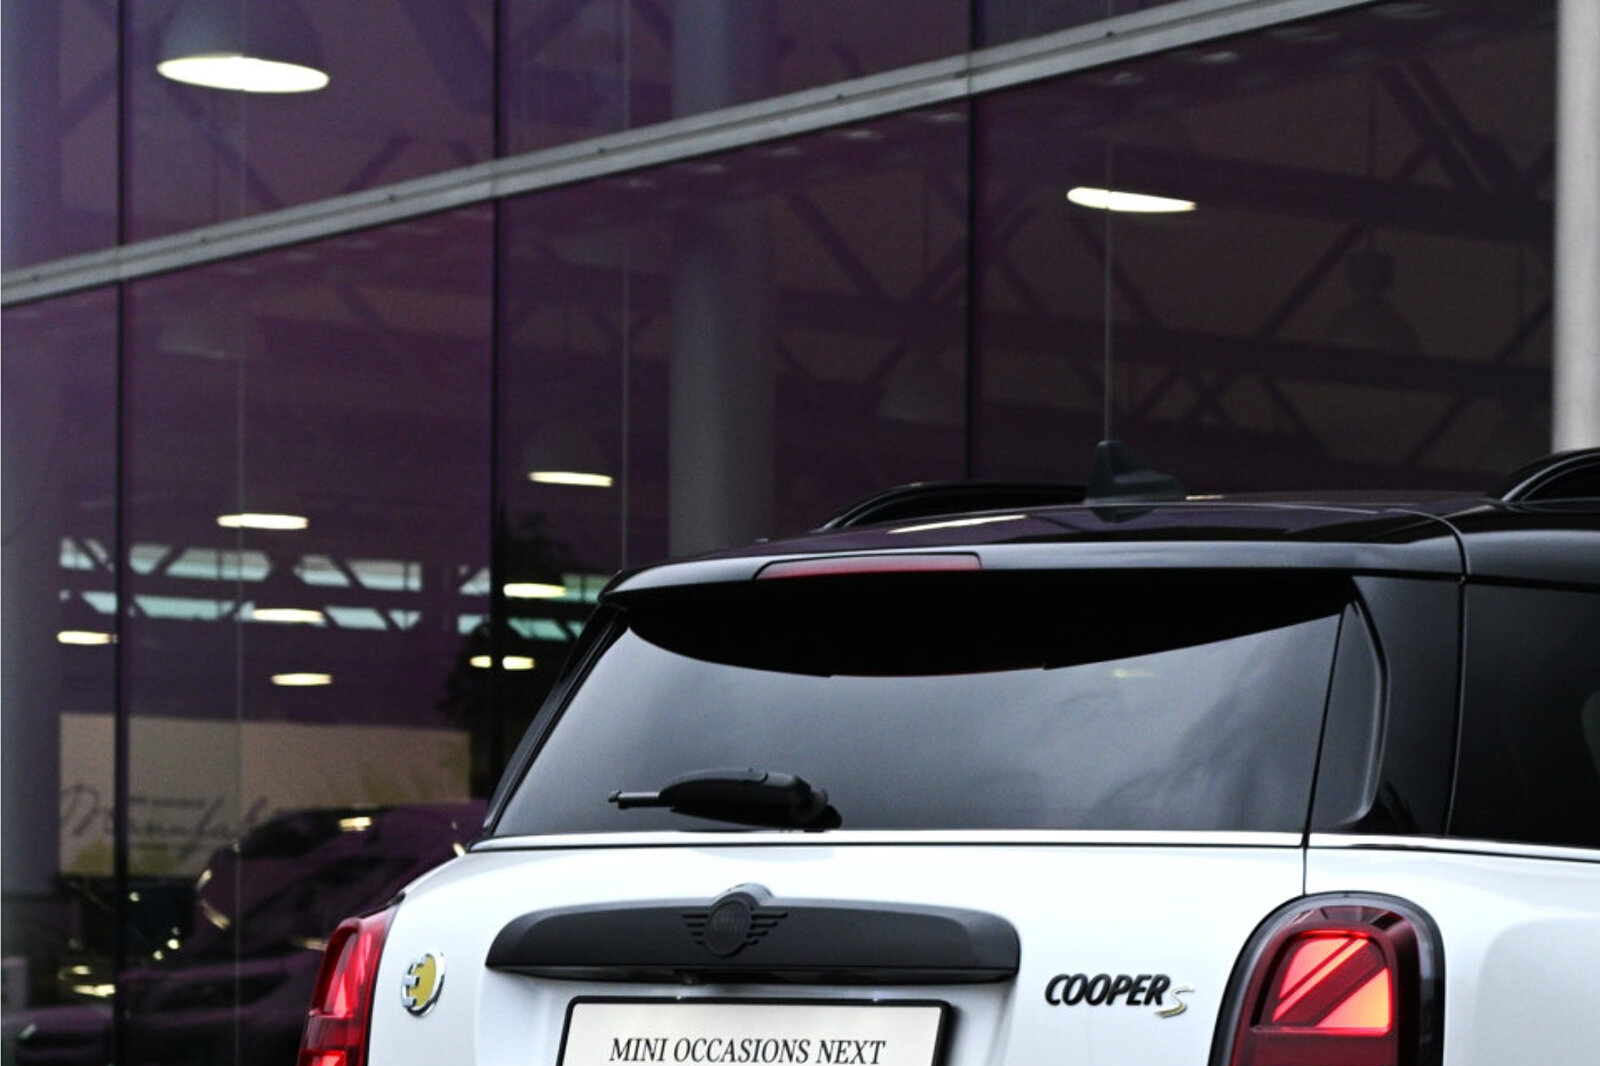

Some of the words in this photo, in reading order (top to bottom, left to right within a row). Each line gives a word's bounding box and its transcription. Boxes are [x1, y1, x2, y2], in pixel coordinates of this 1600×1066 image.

[1045, 973, 1171, 1006] COOPER
[610, 1037, 668, 1062] MINI
[674, 1037, 810, 1064] OCCASIONS
[815, 1039, 886, 1065] NEXT
